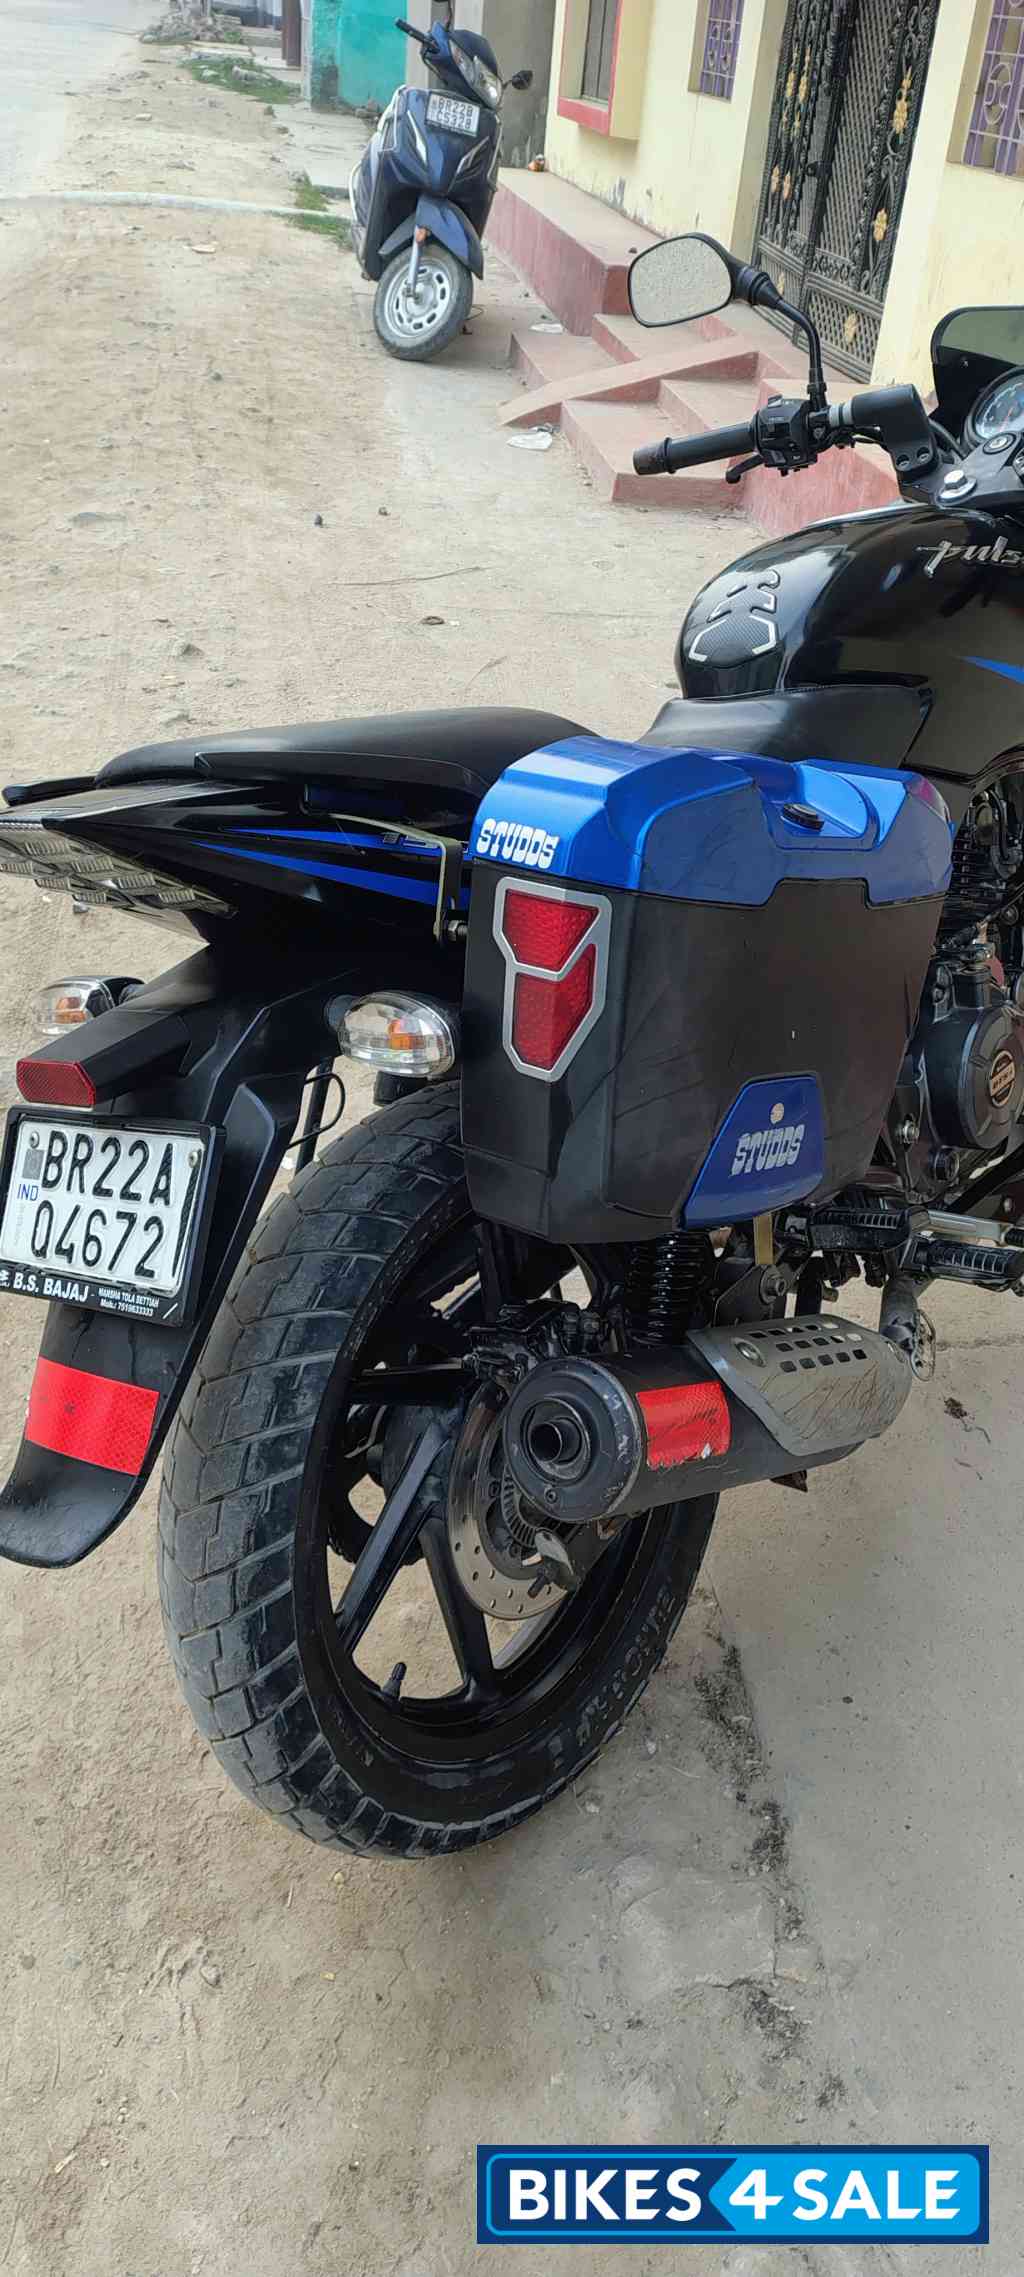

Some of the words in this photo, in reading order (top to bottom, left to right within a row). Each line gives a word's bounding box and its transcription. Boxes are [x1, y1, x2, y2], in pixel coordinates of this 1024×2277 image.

[476, 818, 560, 869] STUDDS
[41, 1130, 173, 1206] BR22A
[729, 1124, 805, 1176] STUDDS
[17, 1184, 39, 1201] IND
[13, 1272, 39, 1293] B.S.
[43, 1278, 89, 1302] BAJAJ
